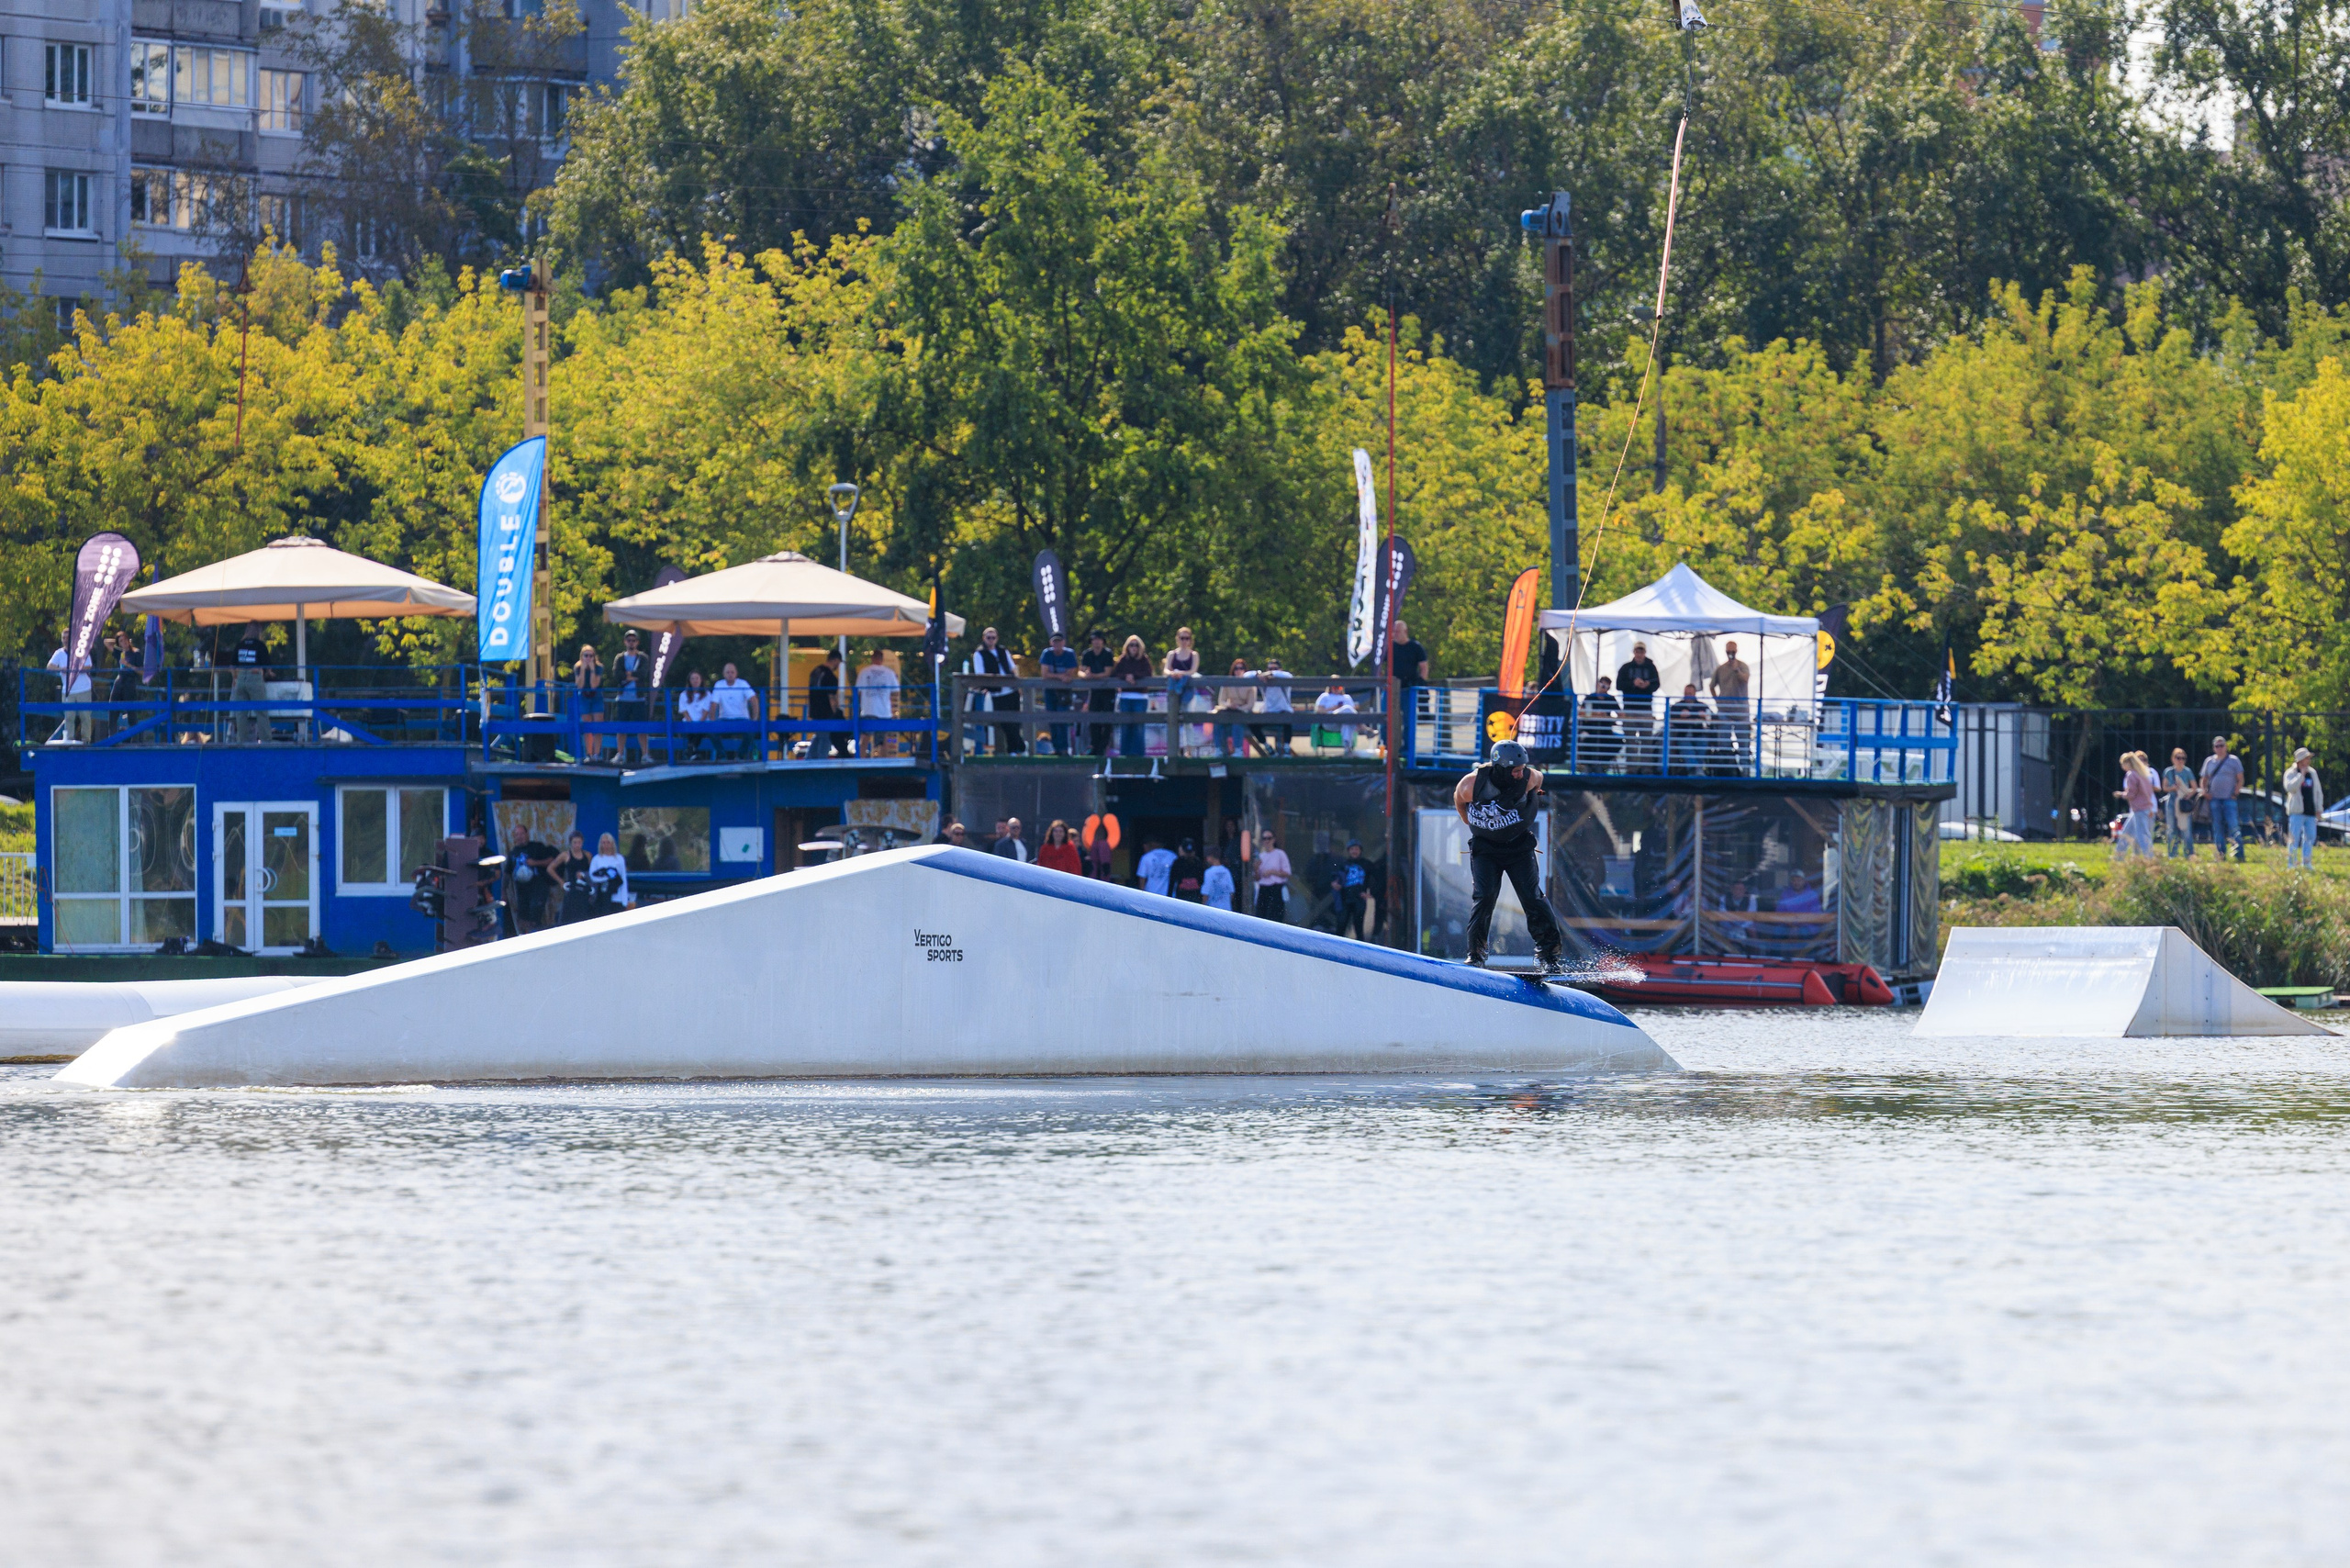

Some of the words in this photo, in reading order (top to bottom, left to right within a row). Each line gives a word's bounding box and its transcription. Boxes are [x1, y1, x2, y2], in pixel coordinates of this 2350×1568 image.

[489, 514, 520, 646] DOUBLE
[75, 623, 93, 657] COOL
[1374, 631, 1385, 666] COOL
[652, 655, 666, 689] COOL
[1518, 714, 1565, 733] DIRTY
[1516, 734, 1563, 749] HABITS
[1467, 812, 1487, 829] OPEN
[914, 929, 952, 946] VERTIGO
[927, 949, 963, 961] SPORTS
